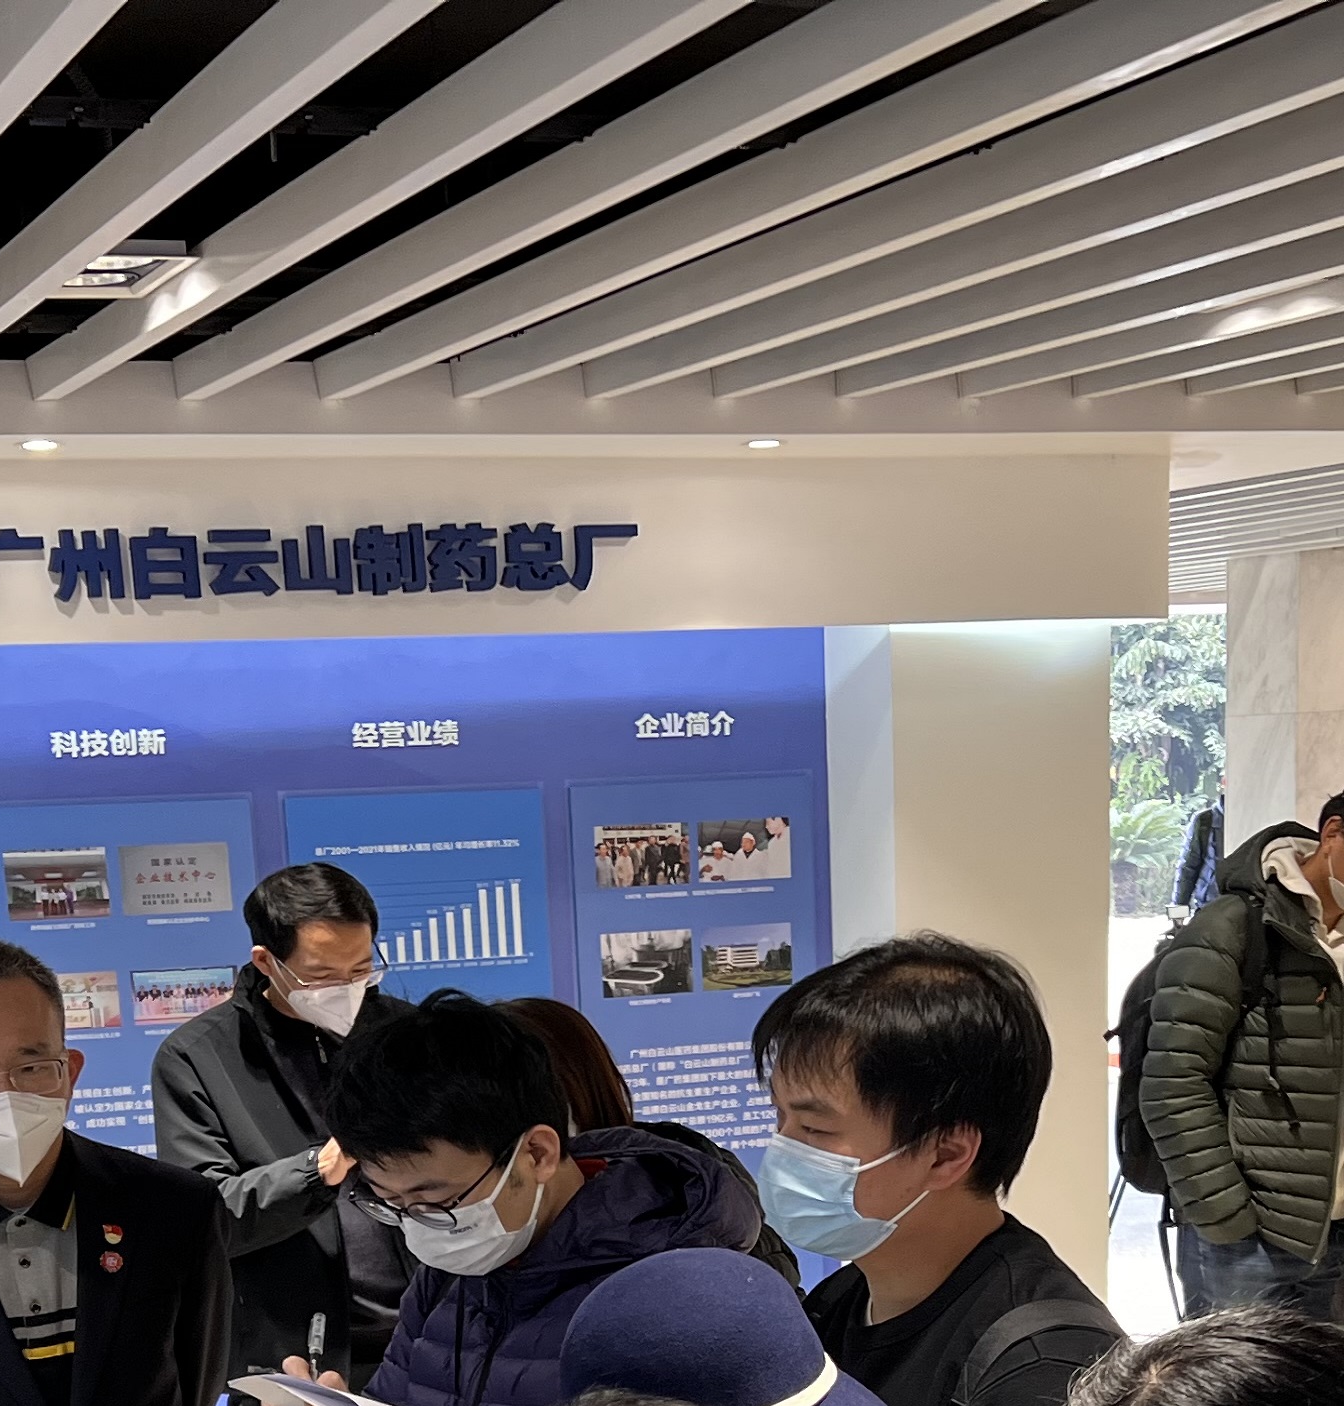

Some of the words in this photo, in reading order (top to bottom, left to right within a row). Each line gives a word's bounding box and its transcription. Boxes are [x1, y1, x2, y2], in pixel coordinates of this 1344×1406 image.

[351, 718, 460, 749] 经营业绩
[634, 709, 735, 740] 企业简介
[49, 728, 167, 759] 科技创新
